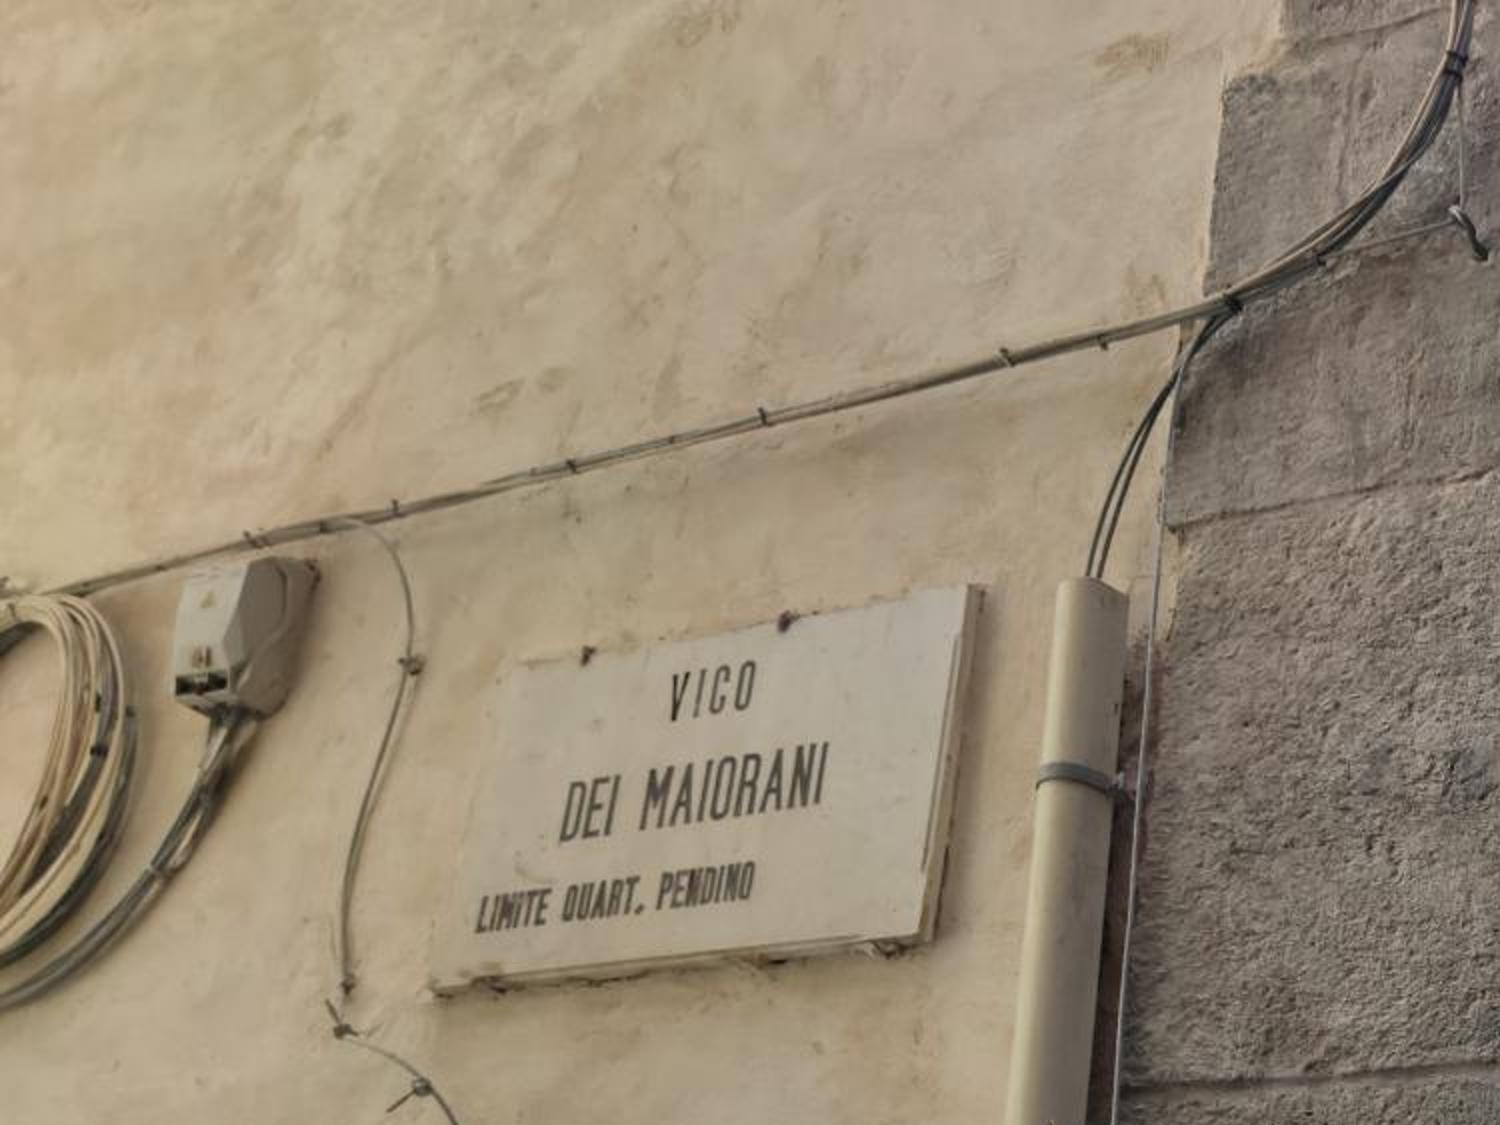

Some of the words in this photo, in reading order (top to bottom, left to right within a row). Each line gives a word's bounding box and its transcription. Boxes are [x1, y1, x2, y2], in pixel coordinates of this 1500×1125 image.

[671, 660, 757, 722] VICO
[559, 775, 621, 842] DEI
[640, 741, 829, 831] MAIORANI
[475, 888, 552, 934] LIMITE
[655, 861, 755, 910] PENDINO
